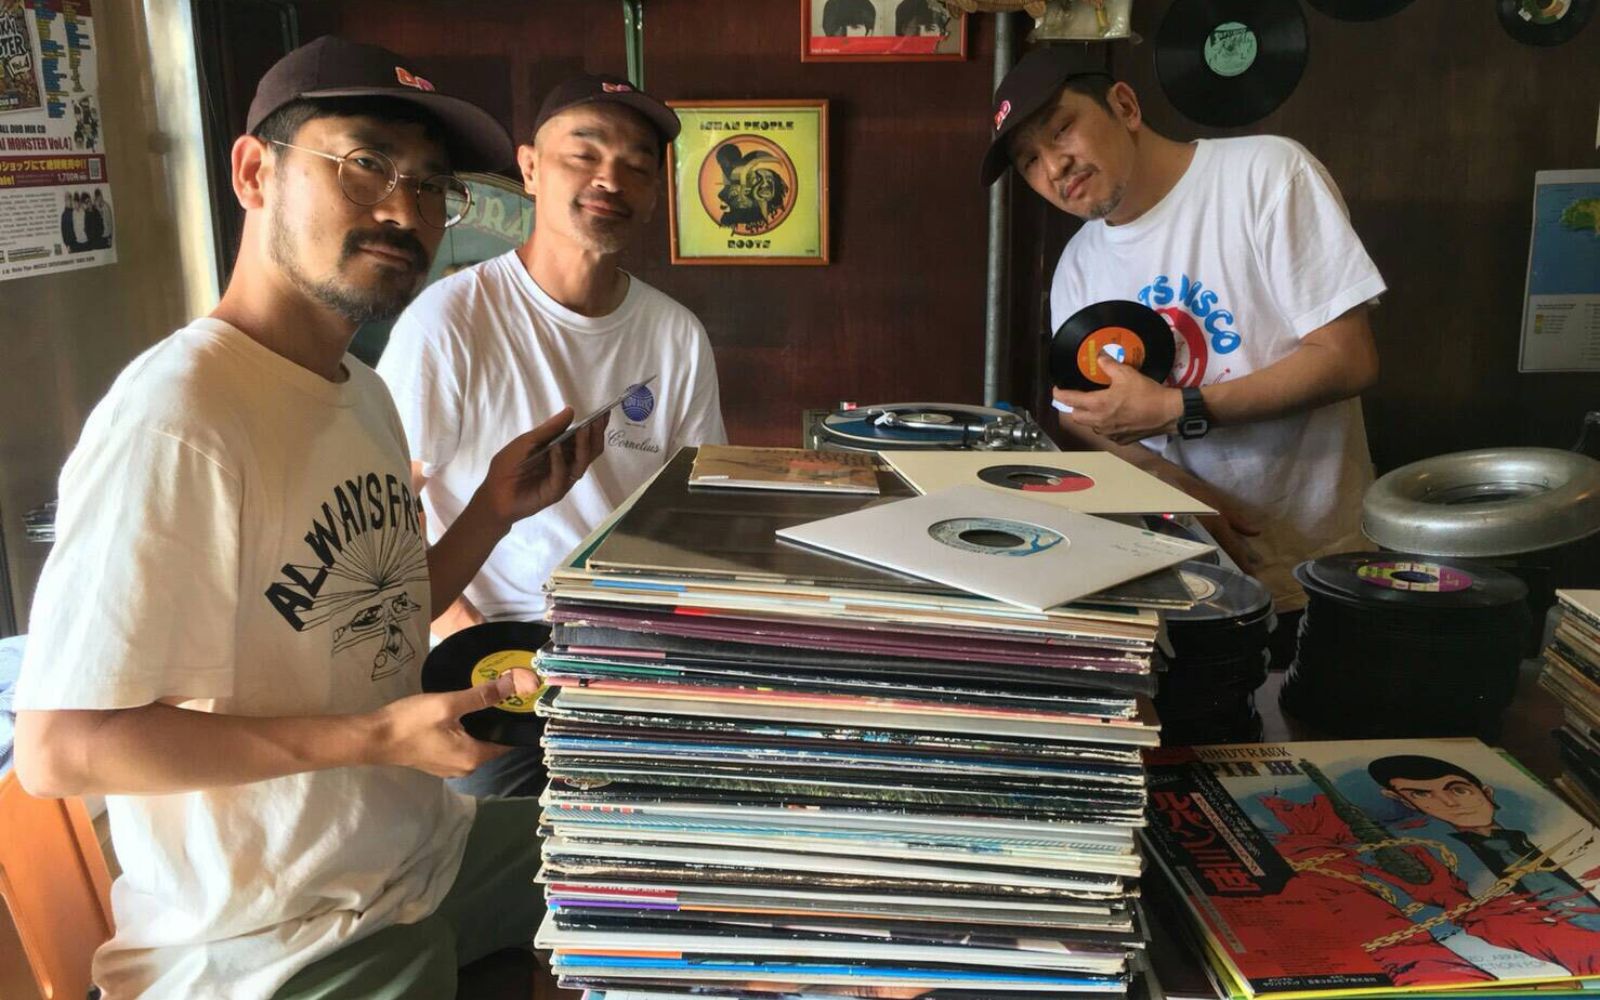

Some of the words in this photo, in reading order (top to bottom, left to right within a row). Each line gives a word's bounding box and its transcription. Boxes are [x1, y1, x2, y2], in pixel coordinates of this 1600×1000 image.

[744, 121, 795, 130] PEOPLE
[7, 137, 48, 150] MONSTER
[727, 239, 771, 249] ROOTS
[607, 428, 660, 454] Cornelius
